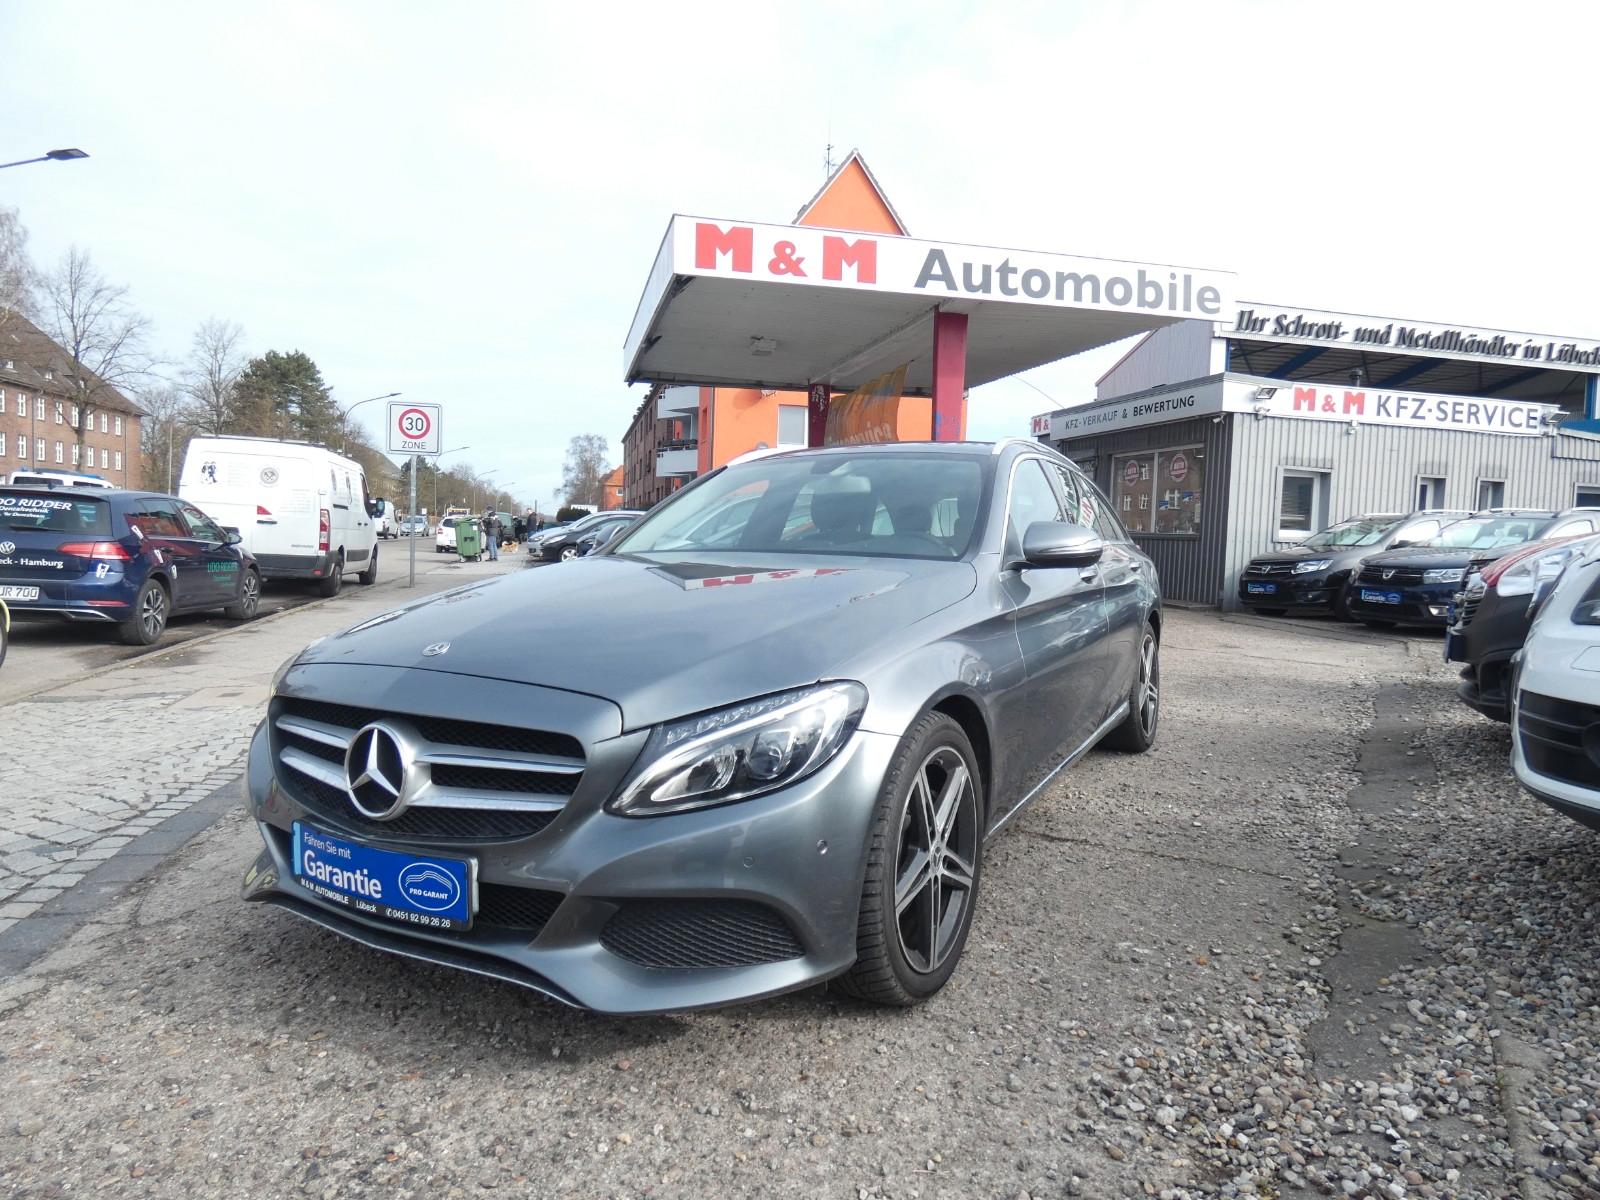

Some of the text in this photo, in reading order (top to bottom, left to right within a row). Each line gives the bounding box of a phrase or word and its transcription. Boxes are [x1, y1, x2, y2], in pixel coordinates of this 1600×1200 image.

[695, 222, 1222, 314] M & M Automobile
[1235, 309, 1271, 332] Ihr
[1272, 313, 1350, 340] Schrott-
[1353, 323, 1394, 345] und
[1394, 326, 1522, 358] Metallhändler
[1523, 338, 1543, 360] in
[1293, 387, 1317, 412] M
[1322, 394, 1336, 413] &
[1342, 391, 1366, 415] M
[1065, 395, 1195, 430] KFZ-VERKAUF & BEWERTUNG
[405, 416, 424, 432] 30
[1033, 418, 1042, 433] M
[401, 440, 427, 450] ZONE
[18, 499, 72, 511] RIDDER
[20, 558, 64, 569] Hamburg
[16, 587, 38, 598] 700
[304, 832, 352, 860] Fahren Sie mit
[304, 850, 382, 899] Garantie
[315, 884, 350, 905] AUTOMOBILE
[356, 900, 377, 913] Lübeck
[410, 913, 419, 923] 92
[420, 915, 429, 925] 99
[409, 887, 449, 900] PRO GARANT
